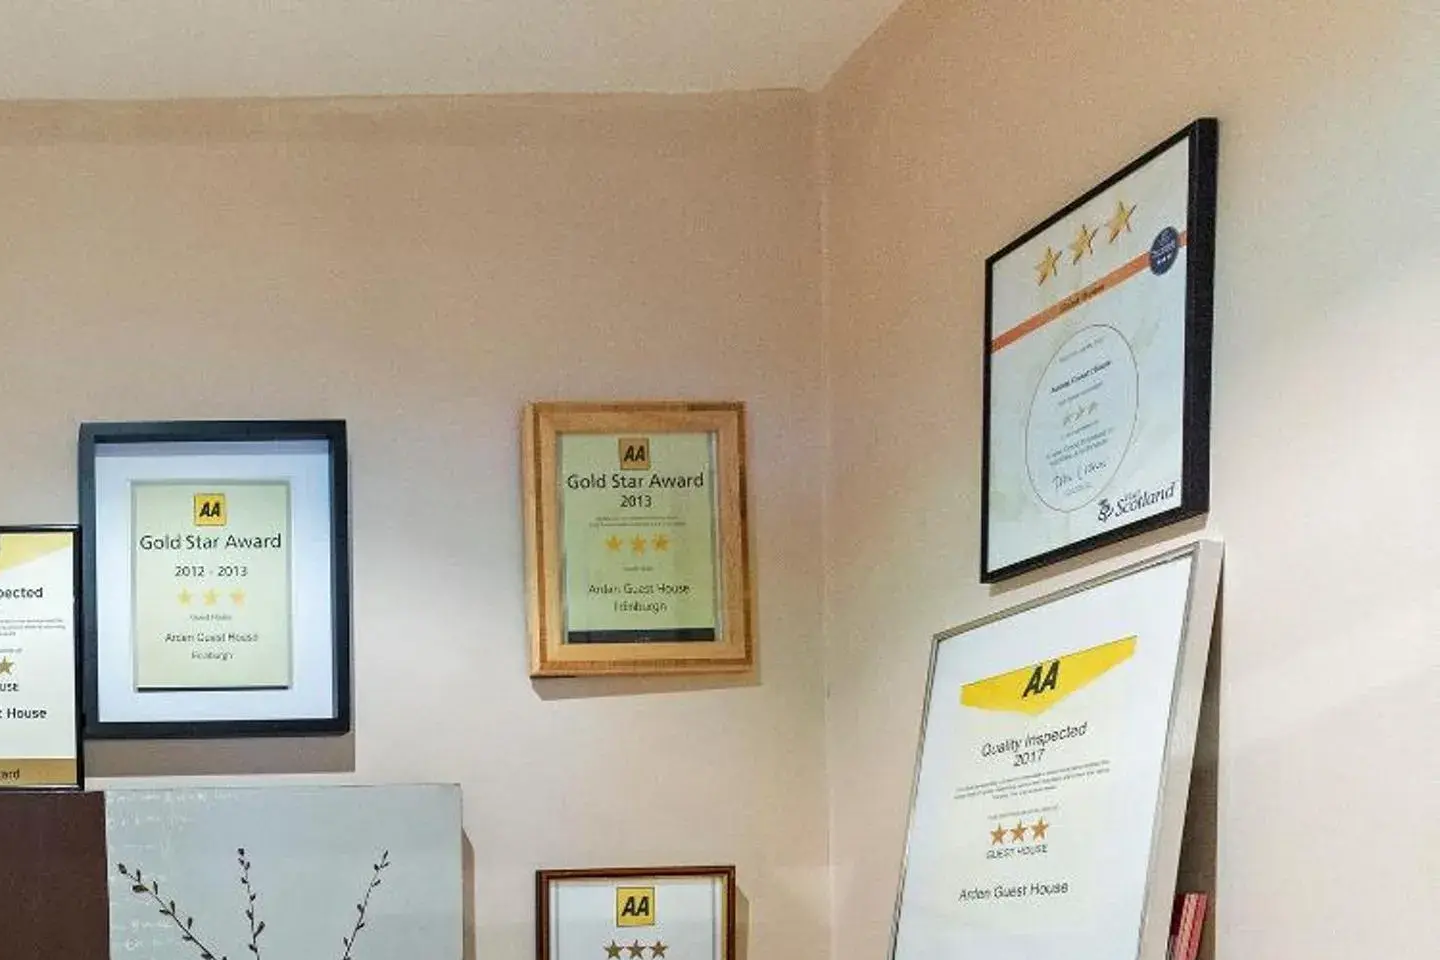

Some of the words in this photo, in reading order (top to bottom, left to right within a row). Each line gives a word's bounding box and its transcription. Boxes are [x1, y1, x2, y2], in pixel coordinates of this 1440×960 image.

[623, 446, 645, 462] AA
[567, 474, 606, 489] Gold
[612, 473, 644, 489] Star
[649, 472, 704, 488] Award
[199, 501, 220, 517] AA
[620, 495, 652, 508] 2013
[140, 534, 181, 550] Gold
[186, 535, 220, 550] Star
[225, 533, 282, 549] Award
[174, 566, 205, 577] 2012
[217, 565, 248, 577] 2013
[1021, 658, 1060, 700] AA
[7, 707, 47, 719] House
[980, 734, 1023, 758] Quality
[1025, 721, 1088, 748] Inspected
[1013, 748, 1046, 767] 2017
[958, 887, 991, 901] Arden
[994, 883, 1027, 899] Guest
[1030, 881, 1069, 896] House
[622, 896, 650, 916] AA
